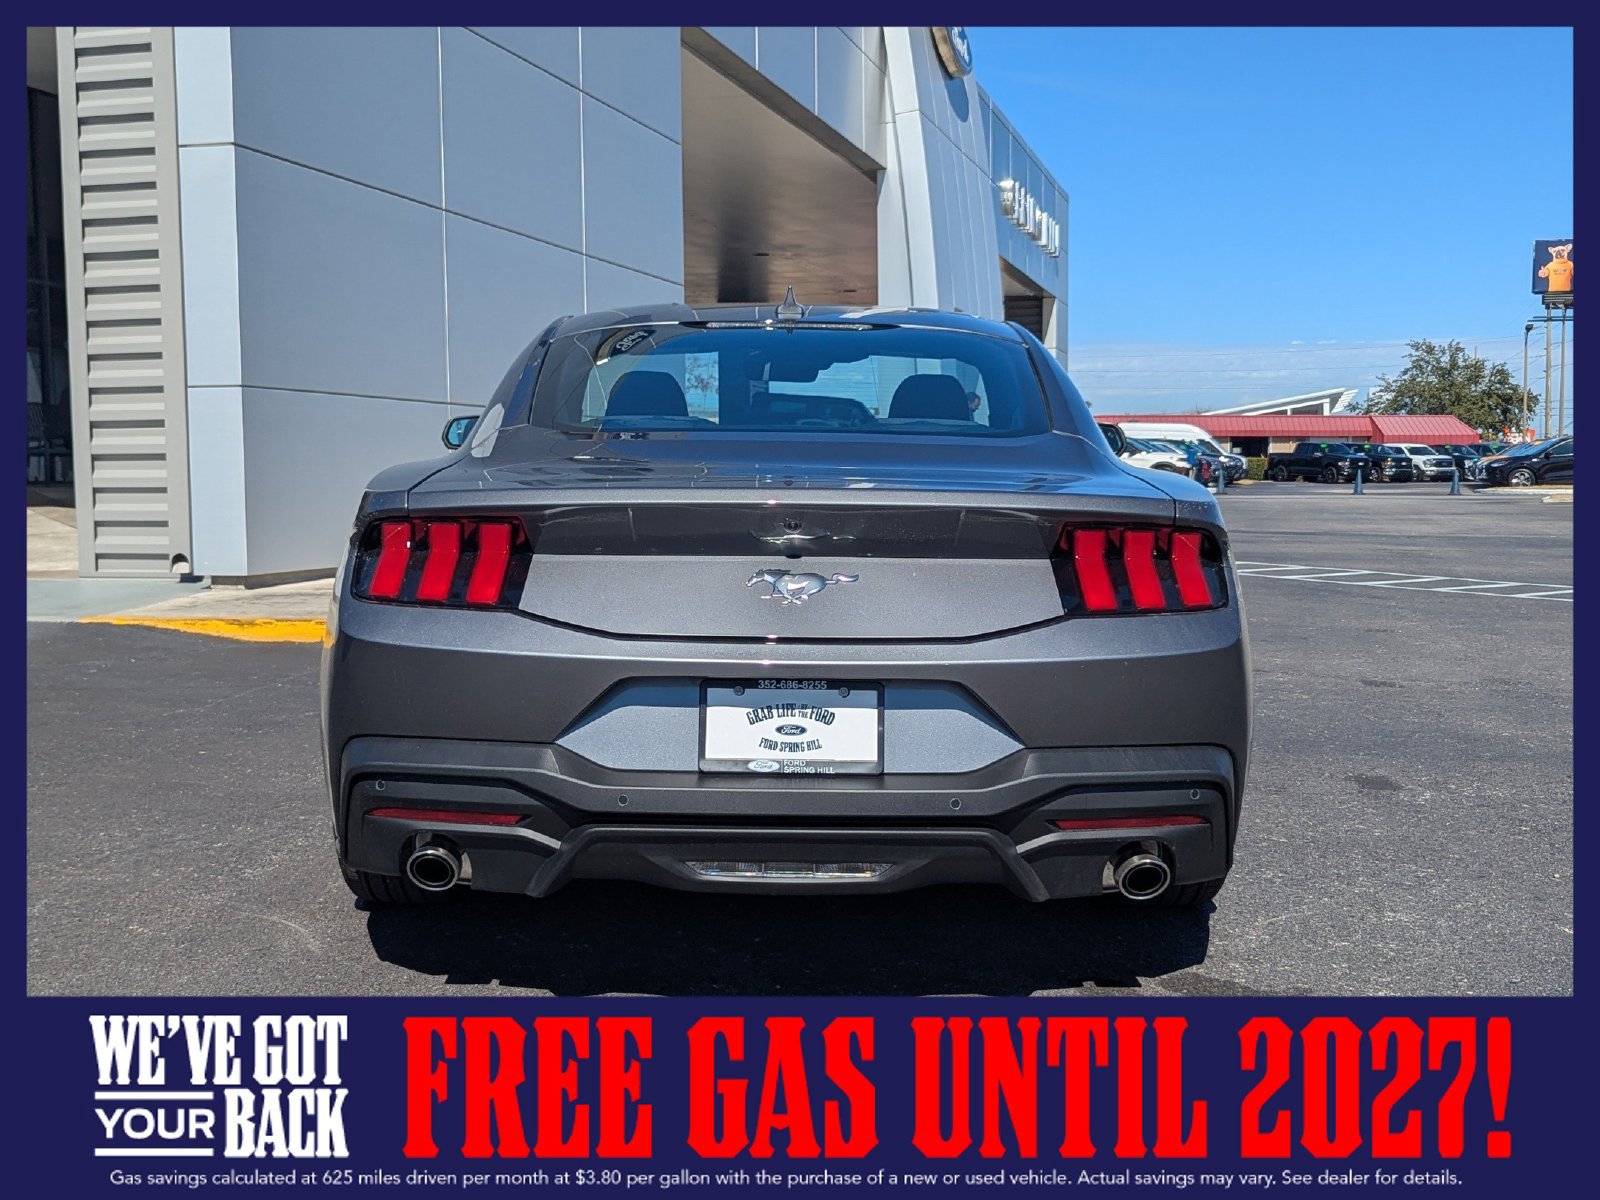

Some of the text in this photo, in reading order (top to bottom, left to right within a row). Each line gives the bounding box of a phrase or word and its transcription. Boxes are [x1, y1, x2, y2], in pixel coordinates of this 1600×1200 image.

[758, 680, 827, 690] 352-686-8255
[746, 702, 836, 726] GRAB LIFE FORD
[798, 710, 809, 718] THE
[781, 725, 801, 734] Ford
[758, 737, 822, 753] FORD SPRING HILL
[783, 766, 835, 774] SPRING HILL
